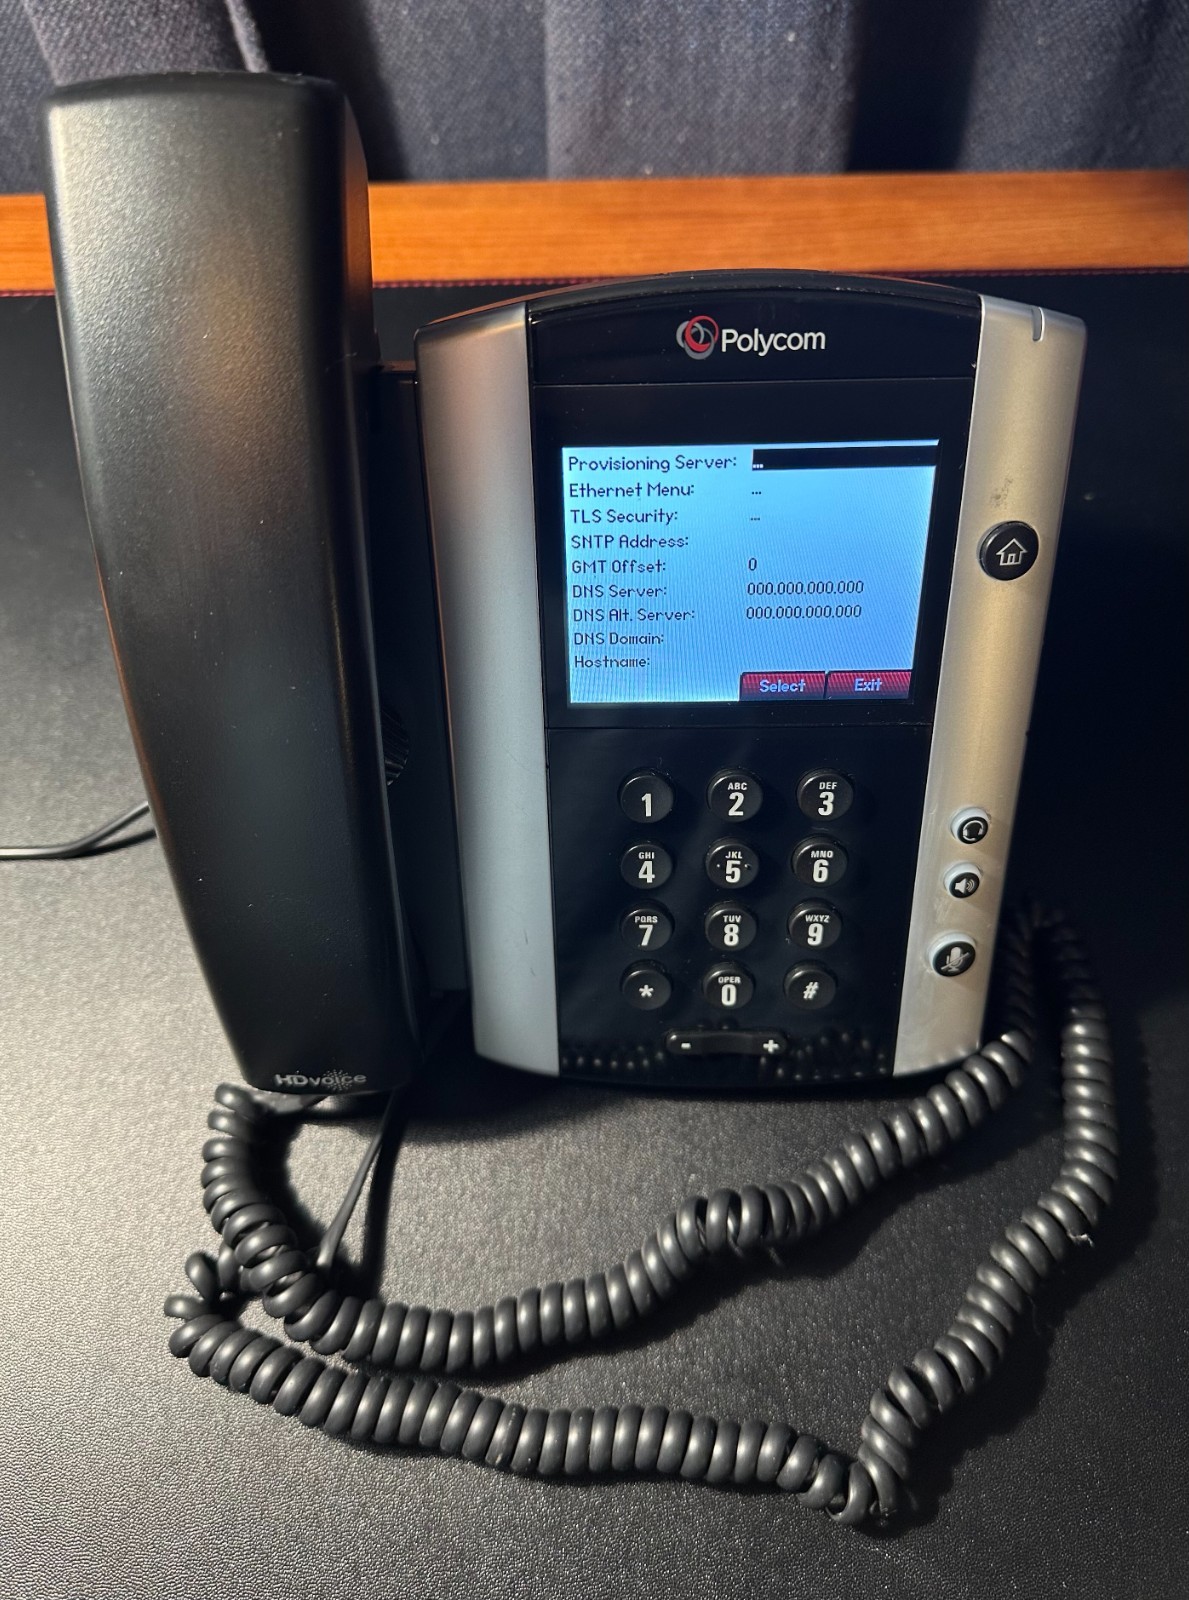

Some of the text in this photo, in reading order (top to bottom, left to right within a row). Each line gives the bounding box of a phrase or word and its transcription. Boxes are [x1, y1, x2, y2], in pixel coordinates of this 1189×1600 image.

[721, 328, 826, 357] Polycom
[569, 455, 737, 474] Provisioning Server:
[569, 484, 695, 498] Ethernet Menu:
[571, 510, 678, 526] TLS Security:
[571, 535, 689, 549] SNTP Address:
[572, 560, 666, 574] GMT Offset:
[748, 558, 757, 571] 0
[572, 585, 667, 598] DNS Server:
[747, 581, 864, 596] 000.000.000.000
[573, 609, 695, 622] DNS Alt. Server:
[746, 605, 862, 620] 000.000.000.000
[574, 632, 664, 646] DNS Domain:
[574, 656, 650, 668] Hostname:
[759, 679, 806, 692] Select
[854, 678, 882, 692] Exit
[727, 782, 747, 790] ABC
[819, 782, 837, 790] DEF
[642, 793, 652, 816] 1
[728, 792, 744, 816] 2
[818, 792, 834, 815] 3
[725, 851, 742, 859] JKL
[811, 850, 833, 858] MNO
[638, 861, 655, 883] 4
[725, 860, 741, 883] 5
[813, 859, 828, 882] 6
[723, 915, 741, 923] TUV
[639, 924, 653, 946] 7
[724, 924, 739, 946] 8
[808, 924, 823, 946] 9
[718, 976, 741, 984] OPER
[721, 984, 737, 1006] 0
